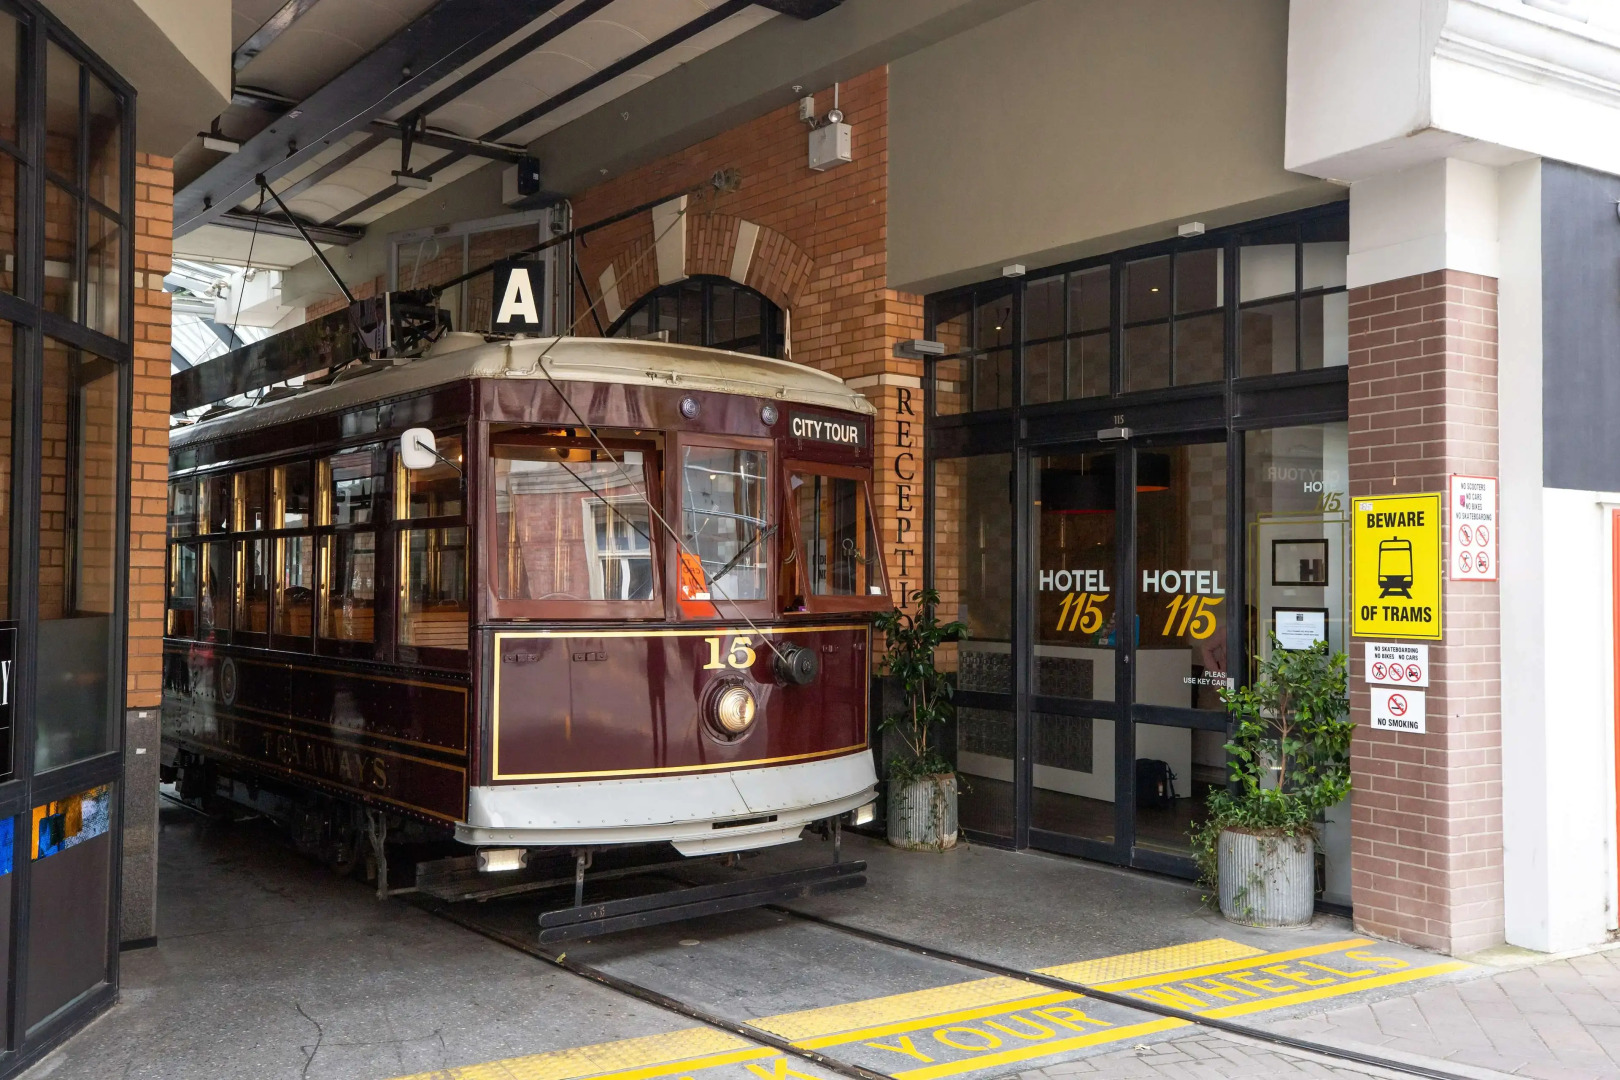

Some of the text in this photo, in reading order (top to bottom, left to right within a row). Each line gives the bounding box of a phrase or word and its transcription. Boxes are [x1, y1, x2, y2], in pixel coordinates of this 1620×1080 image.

[496, 268, 539, 324] A
[792, 417, 859, 444] CITY TOUR
[1114, 414, 1125, 425] 115
[1466, 502, 1471, 510] NO
[1367, 511, 1425, 528] BEWARE
[1039, 569, 1110, 592] HOTEL
[1143, 569, 1226, 594] HOTEL
[1056, 592, 1110, 634] 115
[1161, 594, 1225, 640] 115
[1361, 605, 1432, 623] OF TRAMS
[703, 636, 757, 670] 15
[1204, 671, 1227, 679] PLEAS
[1211, 679, 1227, 687] CAR
[1377, 718, 1418, 729] NO SMOKING
[863, 950, 1410, 1063] YOUR WHEELS
